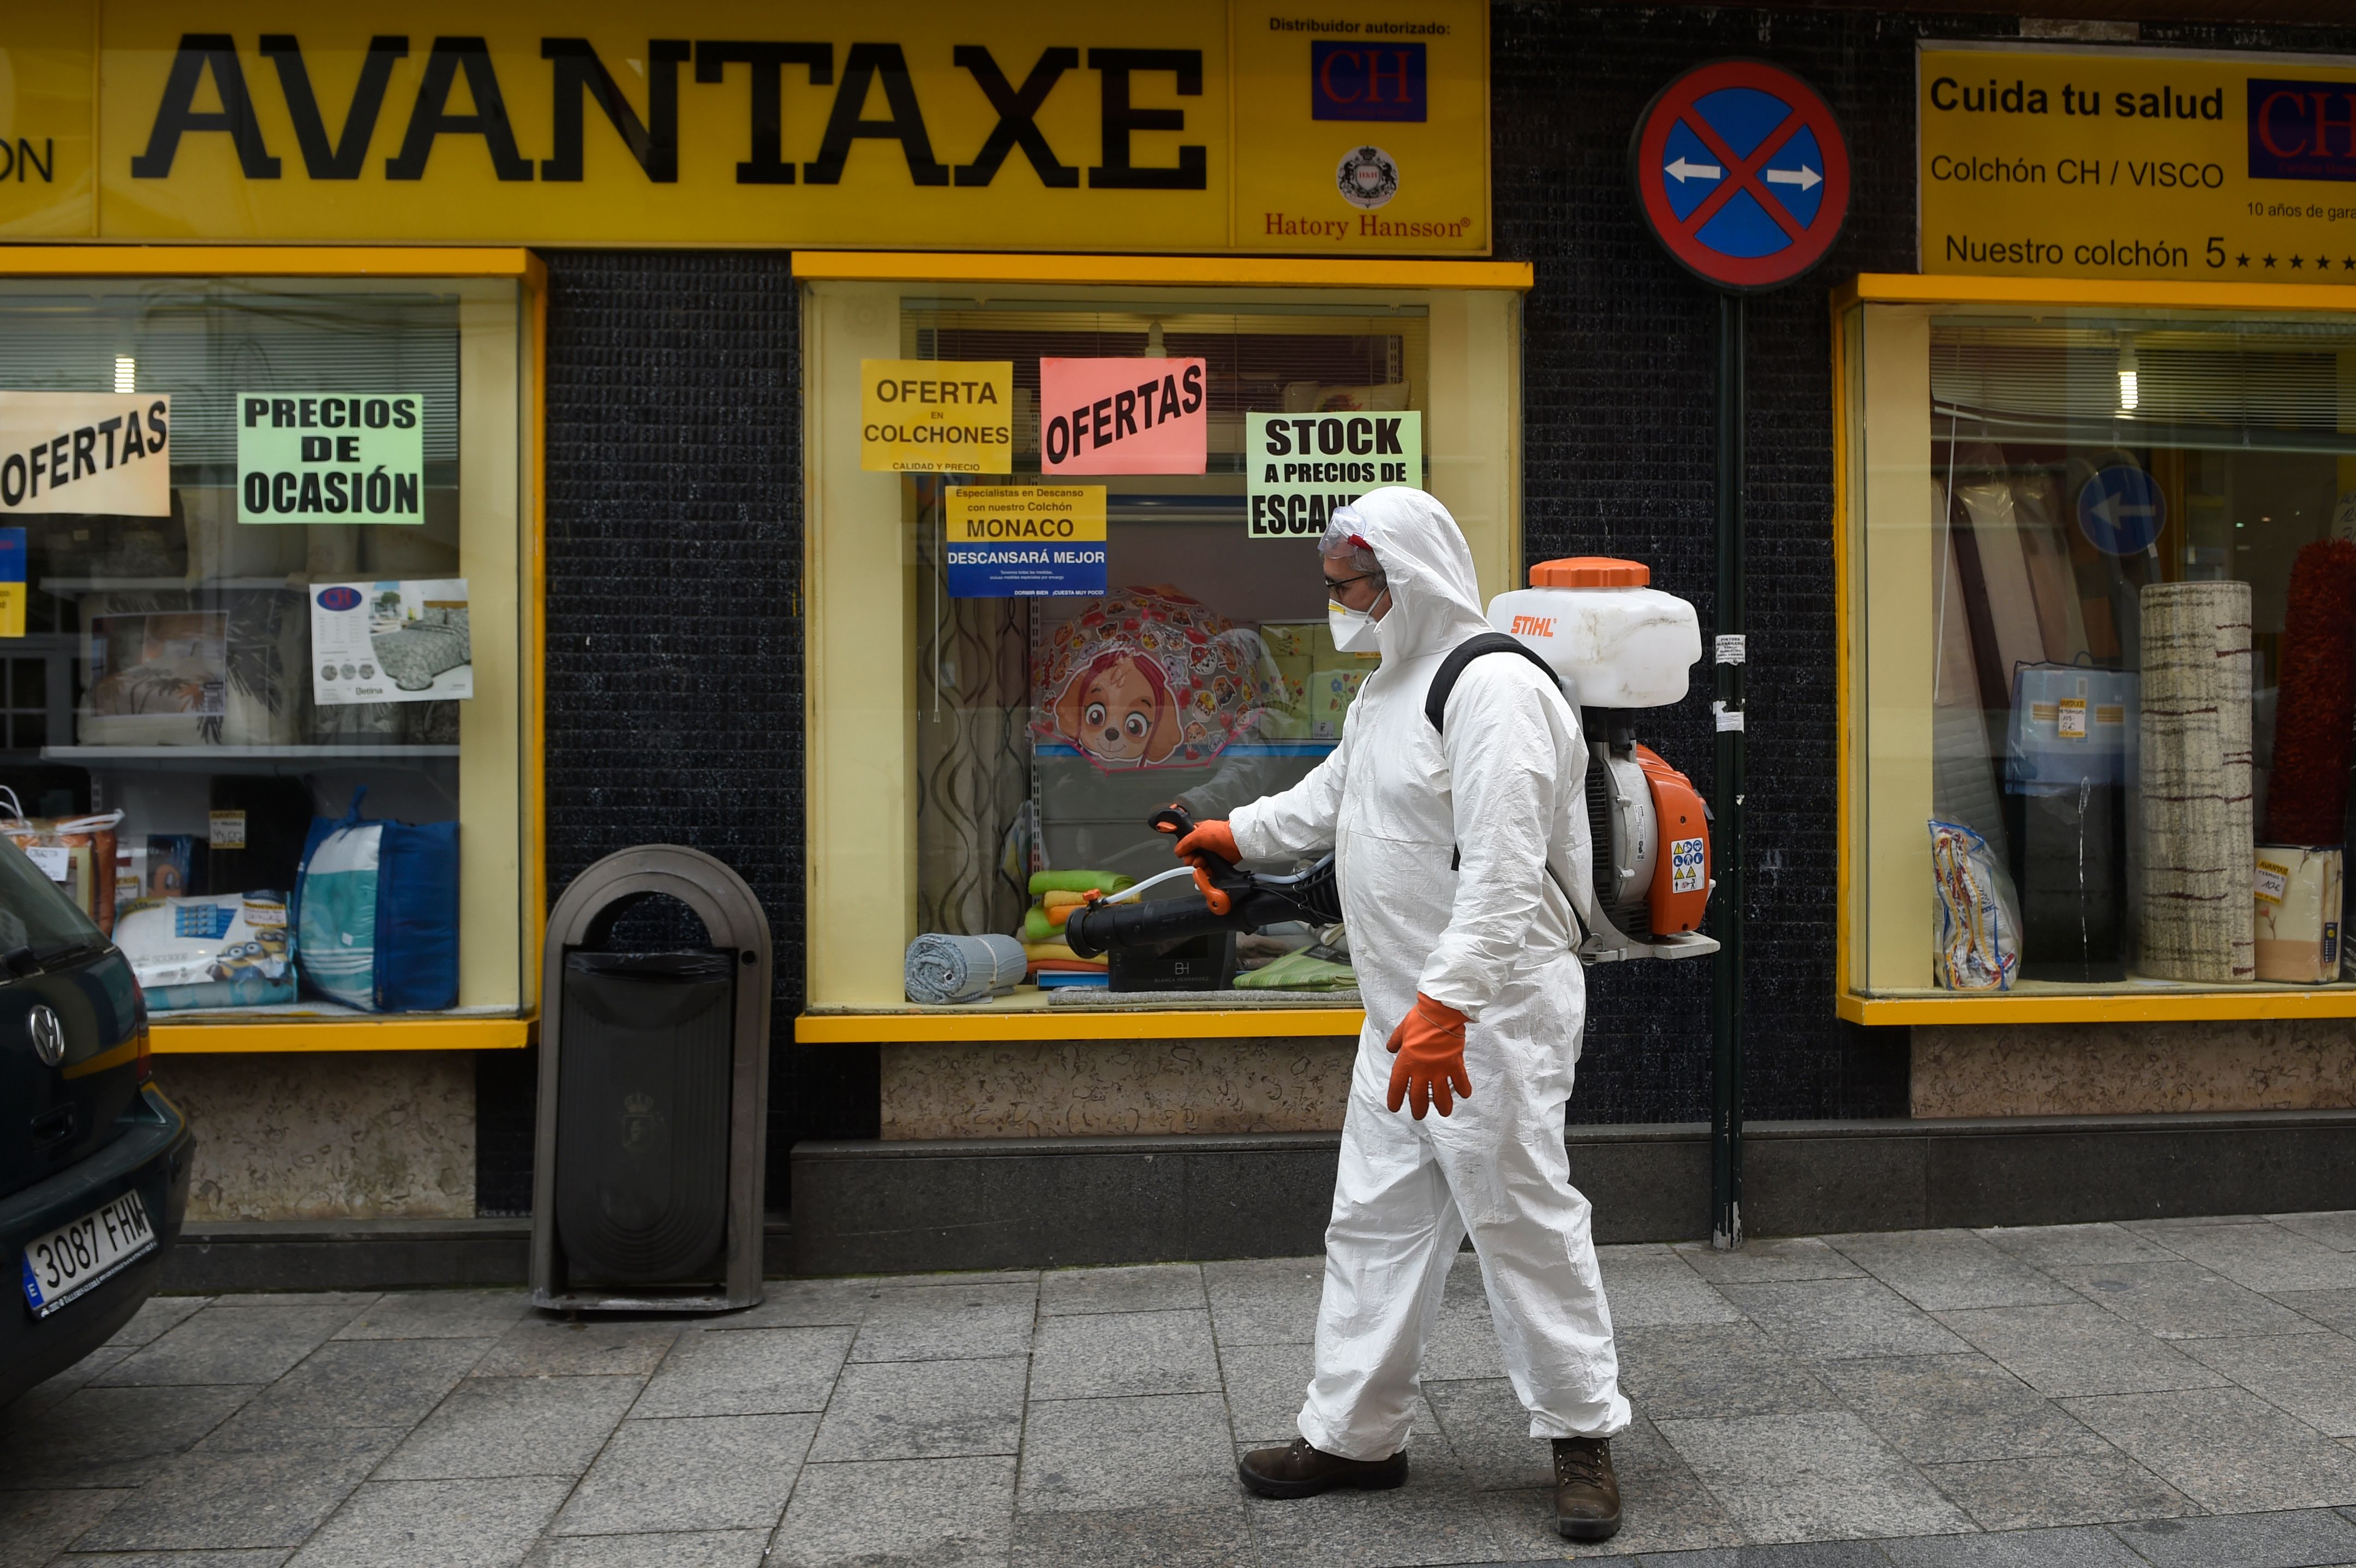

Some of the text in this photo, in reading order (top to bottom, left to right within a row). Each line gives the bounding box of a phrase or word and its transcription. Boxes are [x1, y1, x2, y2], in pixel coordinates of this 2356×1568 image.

[1270, 17, 1451, 35] Distribuidor autorizado:
[1320, 49, 1413, 104] CH
[131, 33, 1207, 190] AVANTAXE
[1930, 77, 2224, 121] Cuida tu salud
[2257, 90, 2356, 158] CH
[1931, 154, 2224, 189] Colchón CH / VISCO
[2247, 201, 2264, 216] 10
[2268, 203, 2302, 217] años
[2306, 204, 2323, 218] de
[1264, 213, 1349, 241] Hatory
[1946, 235, 2226, 268] Nuestro colchón 5
[876, 379, 998, 405] OFERTA
[244, 398, 417, 429] PRECIOS
[930, 411, 944, 420] EN
[1046, 364, 1203, 465] OFERTAS
[864, 424, 1010, 445] COLCHONES
[1264, 417, 1403, 456] STOCK
[1, 400, 168, 507] OFERTAS
[301, 436, 361, 463] DE
[892, 462, 935, 471] CALIDAD
[944, 463, 980, 471] PRECIO
[1264, 462, 1407, 483] A PRECIOS DE
[244, 465, 418, 515] OCASIÓN
[955, 488, 1020, 499] Especialistas
[1036, 488, 1084, 498] Descanso
[988, 503, 1026, 512] nuestro
[1027, 501, 1073, 512] Colchón
[966, 518, 1074, 538] MONACO
[948, 548, 1105, 564] DESCANSARÁ MEJOR
[324, 588, 352, 608] CH
[2261, 881, 2281, 892] 10€
[1175, 962, 1189, 975] BH
[36, 1217, 100, 1289] 3087
[100, 1193, 147, 1252] FHM
[28, 1283, 38, 1297] E
